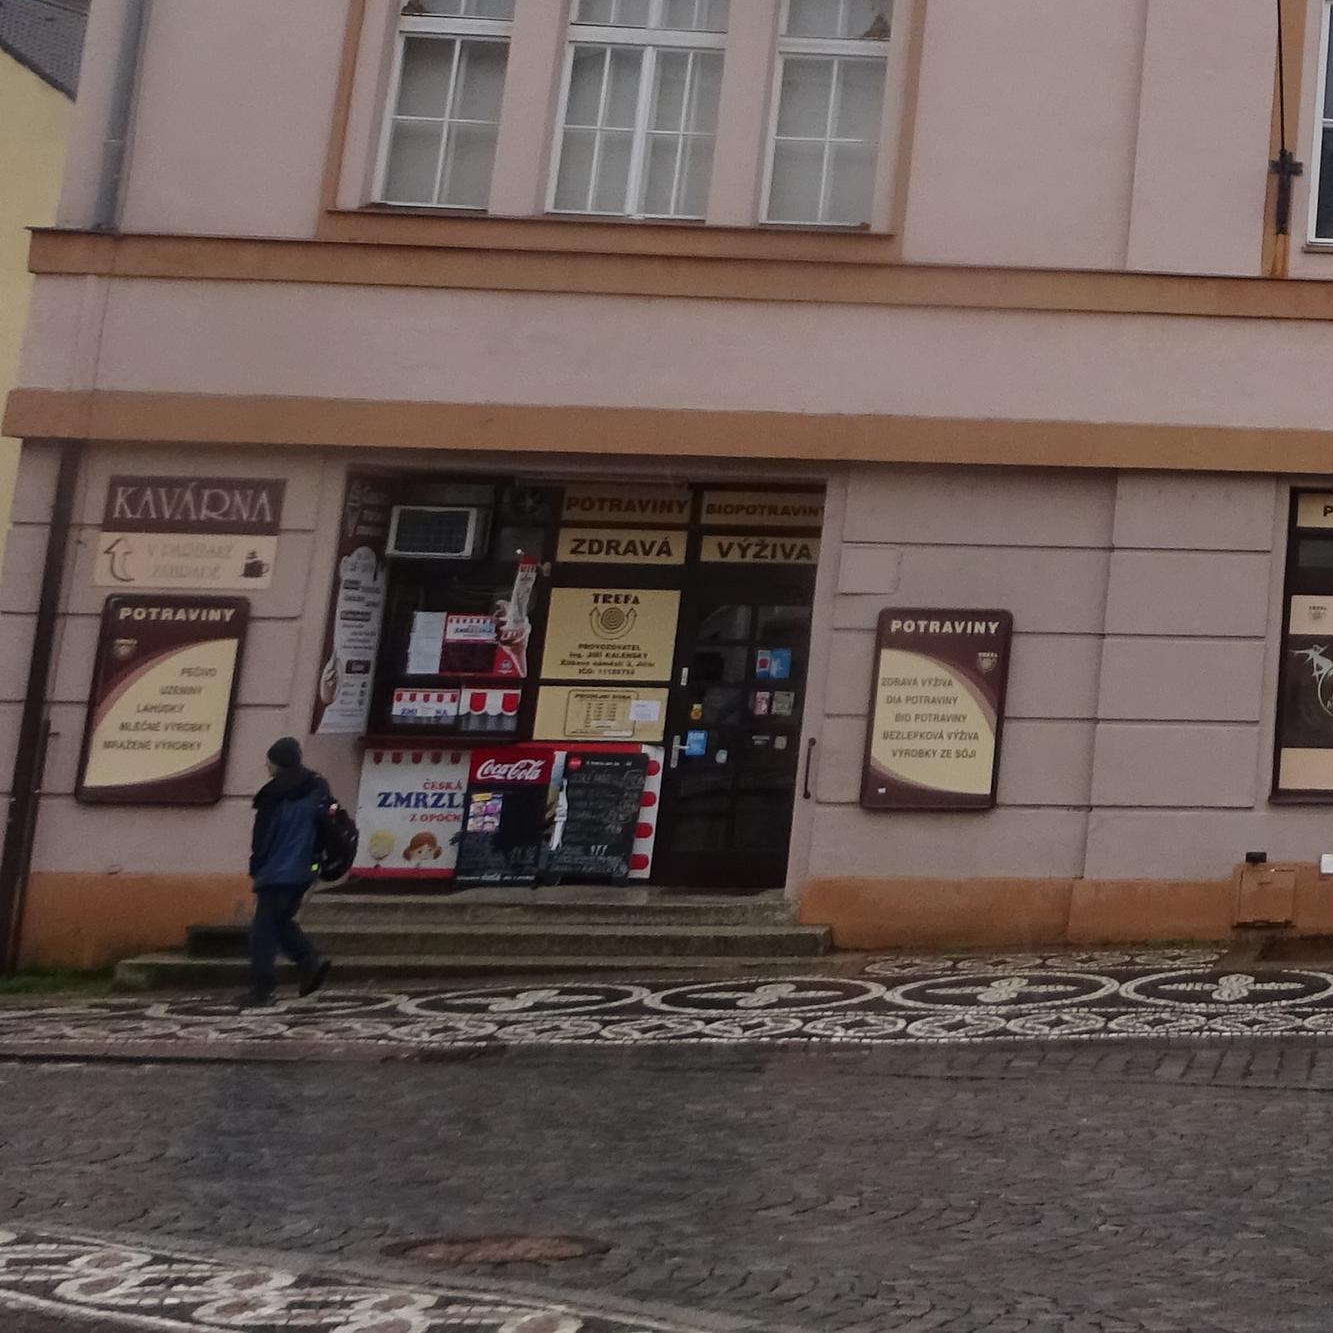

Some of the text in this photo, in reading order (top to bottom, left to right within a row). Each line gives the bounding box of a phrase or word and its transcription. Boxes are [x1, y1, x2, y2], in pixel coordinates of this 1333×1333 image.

[112, 481, 273, 522] KAVÁRNA
[565, 495, 689, 515] POTRAVINY
[706, 502, 824, 517] BIOPOTRAVIN
[569, 536, 673, 558] ZDRAVÁ
[716, 539, 814, 561] VÝŽIVA
[592, 593, 641, 605] TREFA
[118, 607, 236, 622] POTRAVINY
[890, 619, 1000, 635] POTRAVINY
[881, 676, 954, 688] ZDRAVÁ VÝŽIVA
[886, 696, 959, 706] DIA POTRAVINY
[894, 713, 968, 723] BIO POTRAVINY
[882, 730, 980, 741] BEZLEPKOVÁ VÝŽIVA
[891, 747, 937, 759] VÝROBKY
[940, 749, 952, 759] ZE
[422, 778, 464, 791] ČESKÁ
[377, 791, 467, 809] ZMRZL
[409, 814, 417, 822] Z
